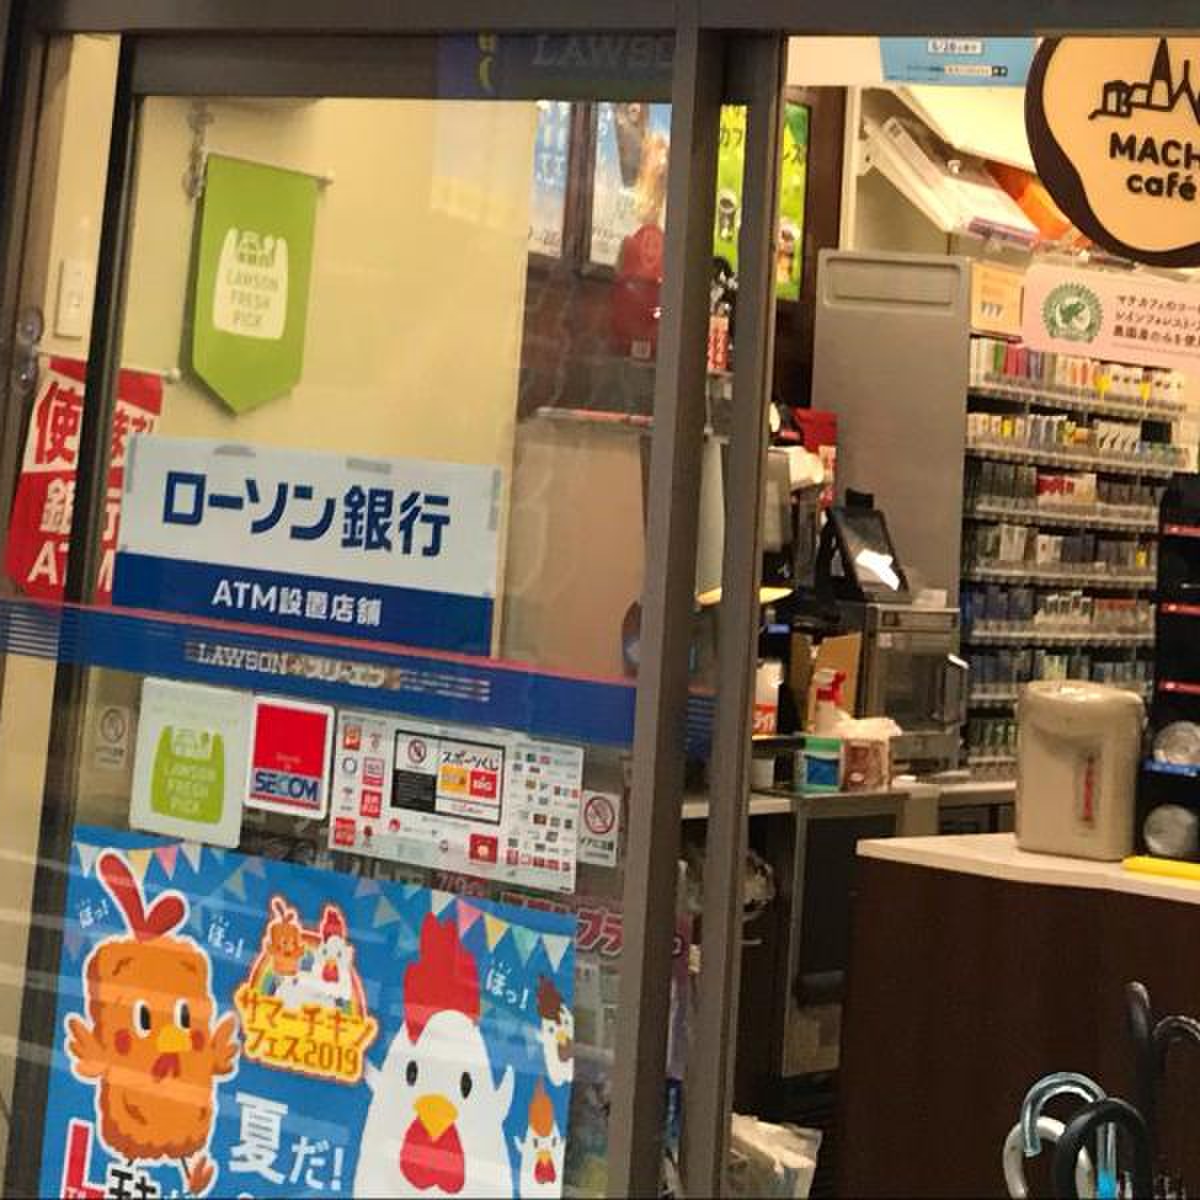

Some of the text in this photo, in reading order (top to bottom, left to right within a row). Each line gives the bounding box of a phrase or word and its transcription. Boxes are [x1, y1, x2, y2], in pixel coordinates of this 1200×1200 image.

[1126, 171, 1197, 202] café
[1117, 295, 1200, 314] マチカフェのコー
[162, 471, 451, 557] ローソン銀行
[210, 579, 383, 628] ATM設置店舗
[198, 643, 288, 676] LAWSON
[255, 772, 319, 801] SECOM
[238, 990, 376, 1047] サマーチキン
[248, 1027, 359, 1075] フェス2019
[228, 1091, 344, 1192] 夏だ!
